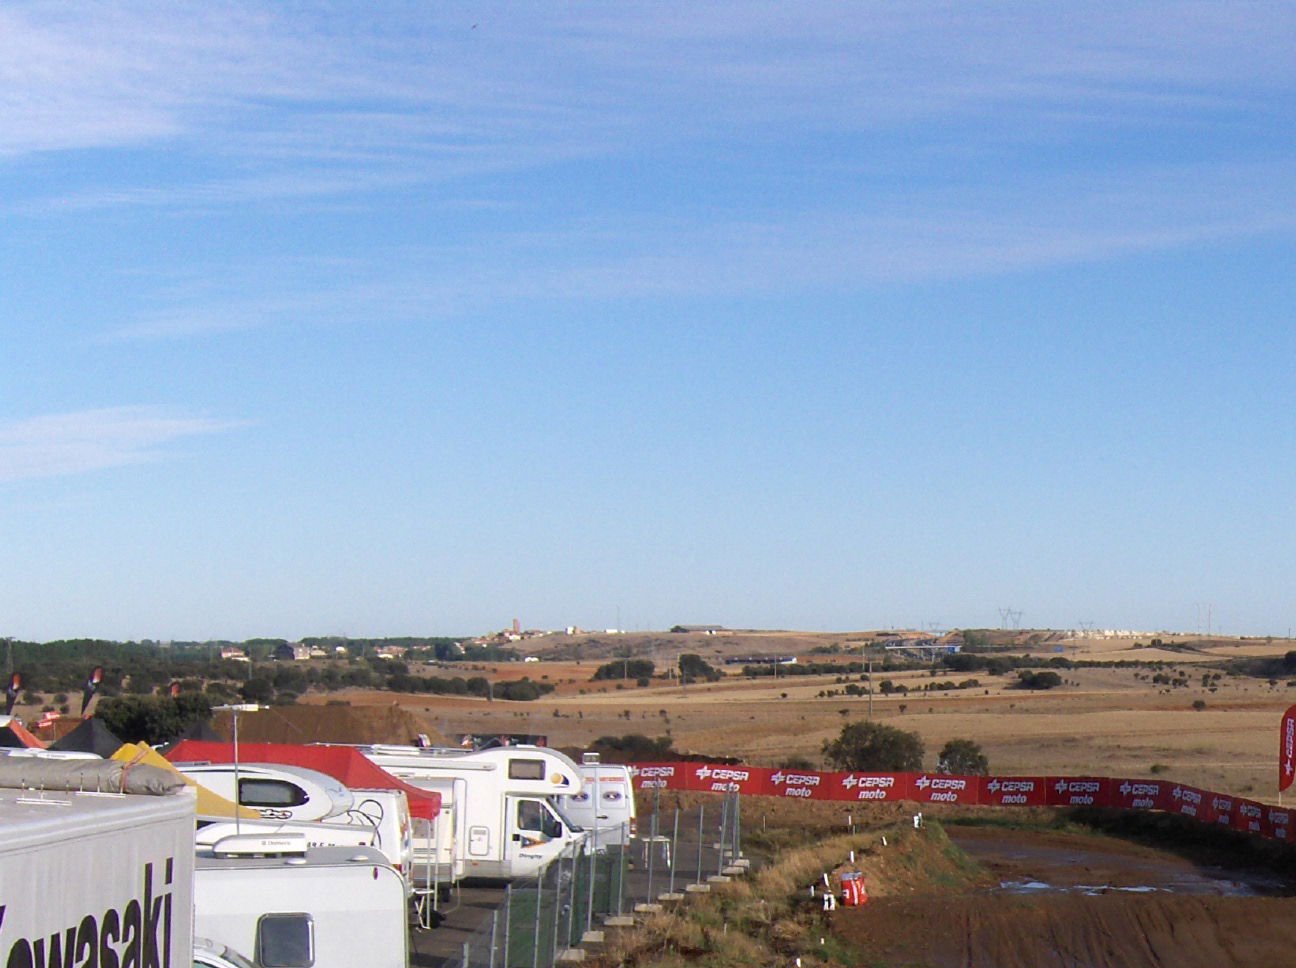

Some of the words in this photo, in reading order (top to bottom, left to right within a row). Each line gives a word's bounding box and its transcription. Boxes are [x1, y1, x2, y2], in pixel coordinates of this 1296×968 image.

[1286, 718, 1295, 758] CEPSA
[640, 767, 674, 777] CEPSA
[712, 769, 749, 781] CEPSA
[786, 774, 820, 786] CEPSA
[858, 777, 895, 788] CEPSA
[931, 778, 966, 790] CEPSA
[785, 787, 812, 797] moto
[1001, 781, 1034, 792] CEPSA
[1069, 782, 1099, 792] CEPSA
[1132, 784, 1159, 795] CEPSA
[858, 788, 887, 799] moto
[931, 792, 957, 802] moto
[1002, 793, 1027, 804] moto
[1070, 794, 1094, 805] moto
